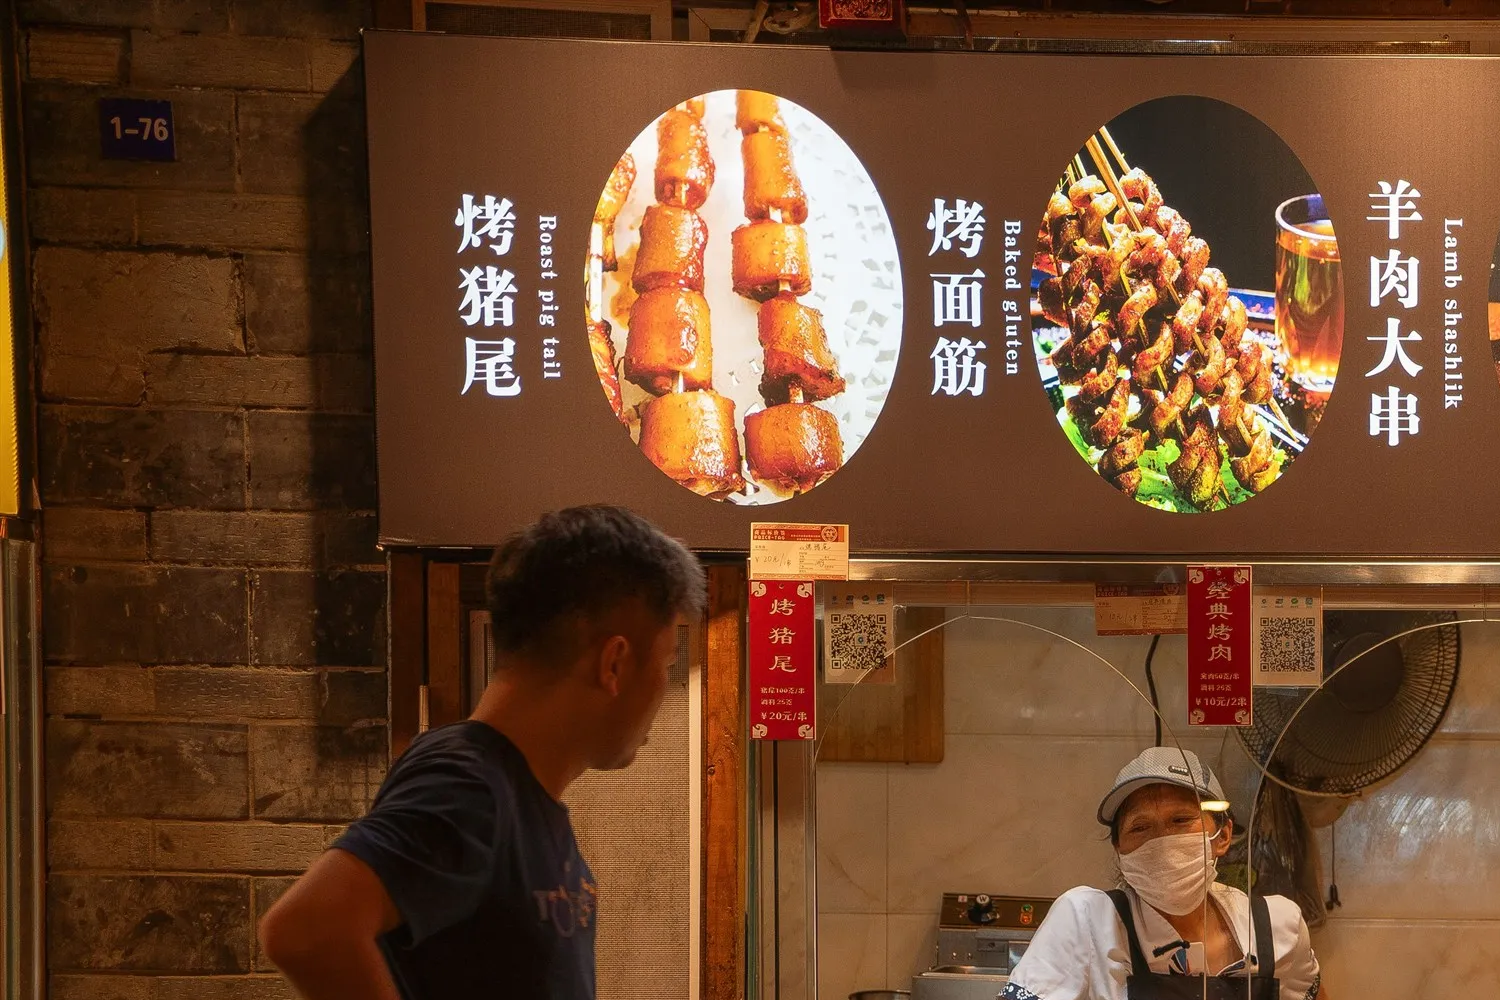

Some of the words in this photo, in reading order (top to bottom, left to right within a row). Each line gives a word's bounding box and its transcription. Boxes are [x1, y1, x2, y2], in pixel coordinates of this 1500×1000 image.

[111, 117, 168, 141] 1-76
[539, 215, 558, 279] Roast
[1004, 220, 1022, 290] Baked
[1444, 218, 1463, 288] Lamb
[455, 194, 521, 396] 烤猪尾
[538, 290, 560, 326] pig
[926, 198, 986, 396] 烤面筋
[1365, 179, 1423, 446] 羊肉大串
[543, 337, 561, 379] tail
[1002, 300, 1023, 375] gluten
[1444, 299, 1463, 409] shashlik
[768, 598, 797, 673] 烤猪尾
